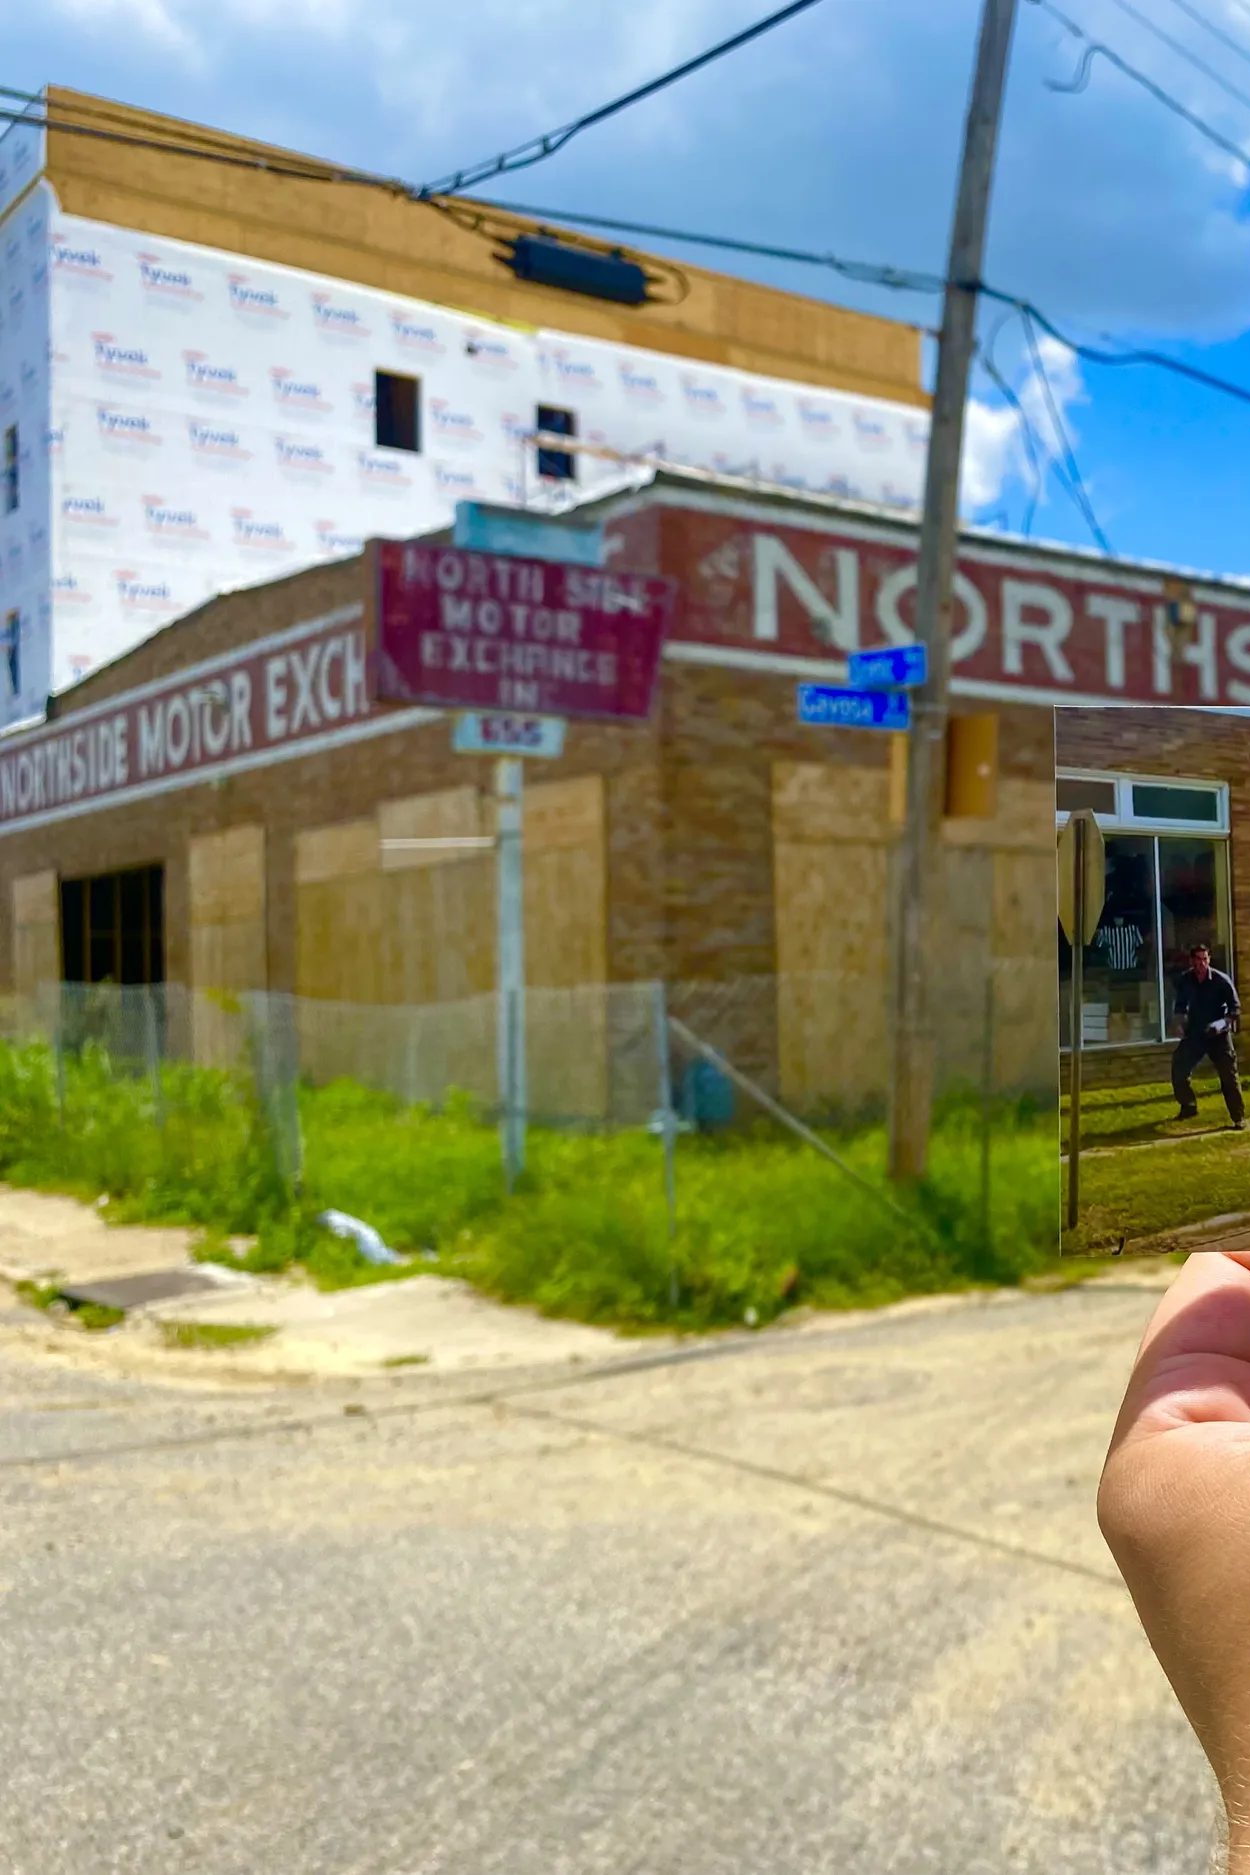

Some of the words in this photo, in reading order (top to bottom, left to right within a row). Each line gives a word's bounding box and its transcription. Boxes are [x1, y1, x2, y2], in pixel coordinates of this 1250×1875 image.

[140, 263, 191, 286] Tyvek
[229, 283, 278, 305] Tyvek
[96, 341, 148, 364] Tyvek
[403, 548, 545, 602] NORTH
[440, 594, 582, 643] MOTOR
[1, 713, 129, 818] NORTHSIDE
[137, 670, 253, 776] MOTOR
[265, 631, 370, 740] EXCH
